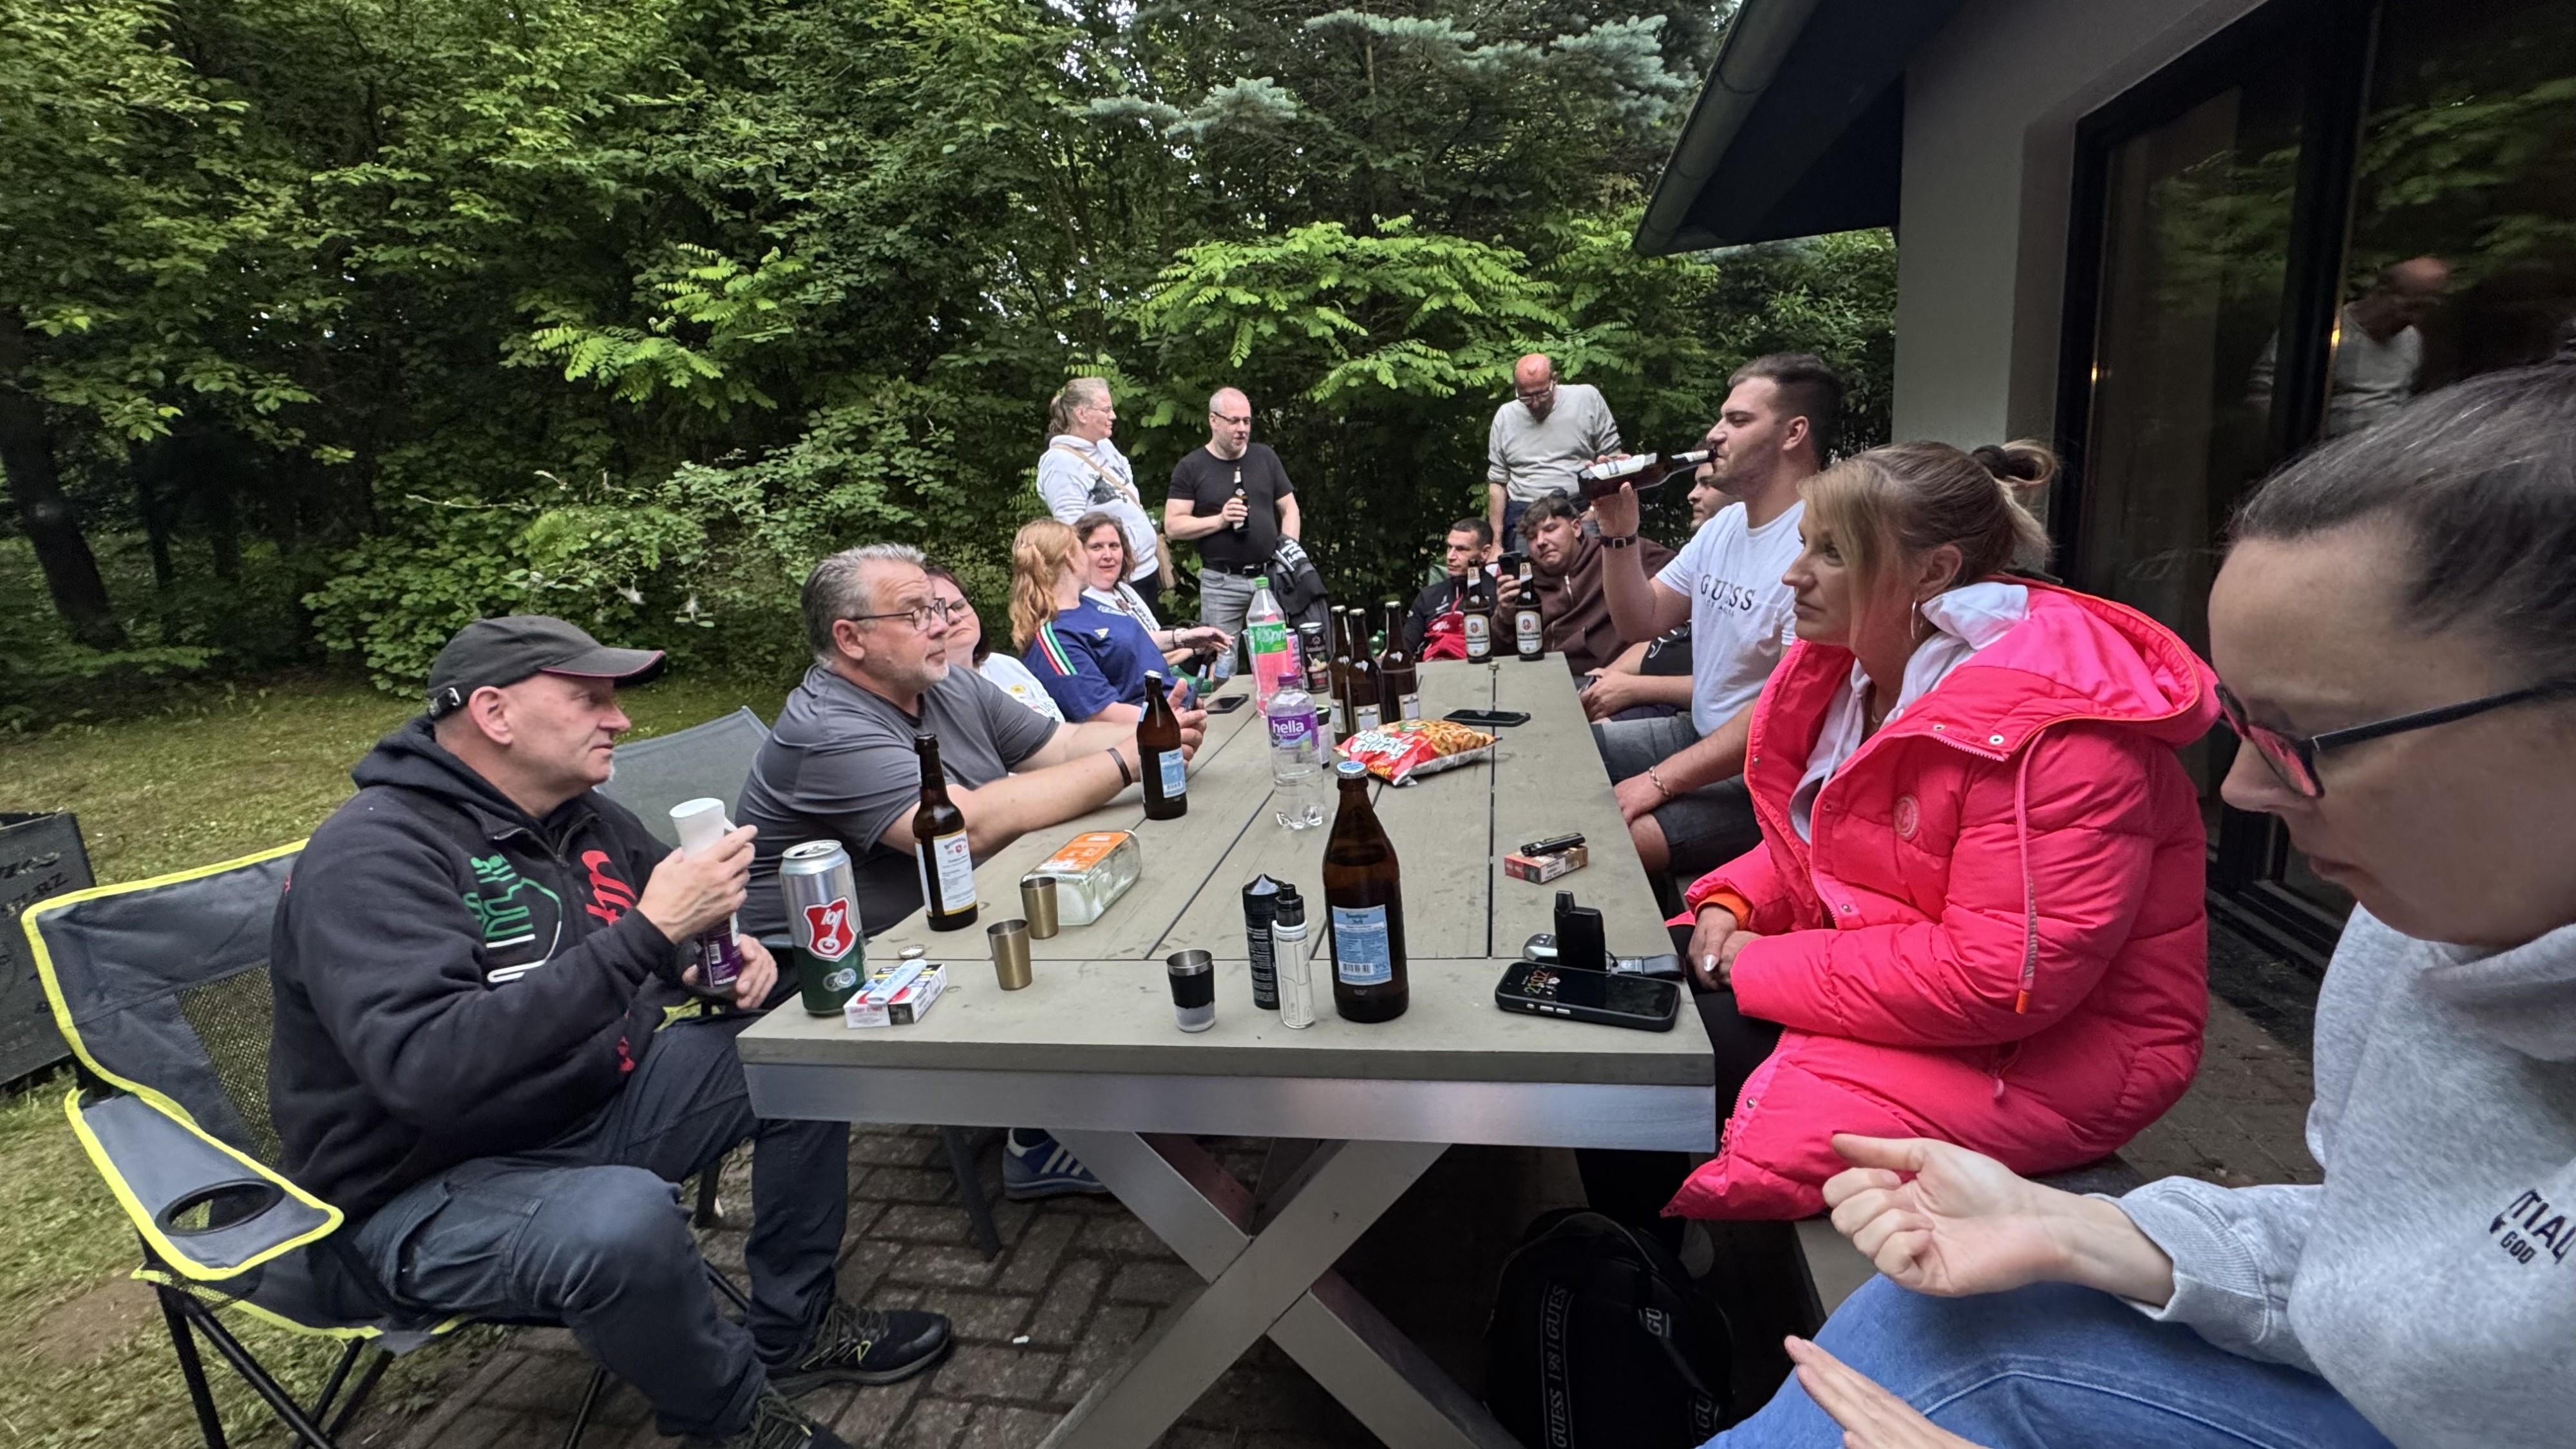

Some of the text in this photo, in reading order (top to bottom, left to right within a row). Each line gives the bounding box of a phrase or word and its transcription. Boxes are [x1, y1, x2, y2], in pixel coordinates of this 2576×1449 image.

[1701, 574, 1756, 611] GUSS
[1272, 719, 1305, 734] hella
[2500, 1231, 2537, 1264] GOD
[1546, 1341, 1563, 1383] 1981
[1550, 1388, 1568, 1448] GUESS
